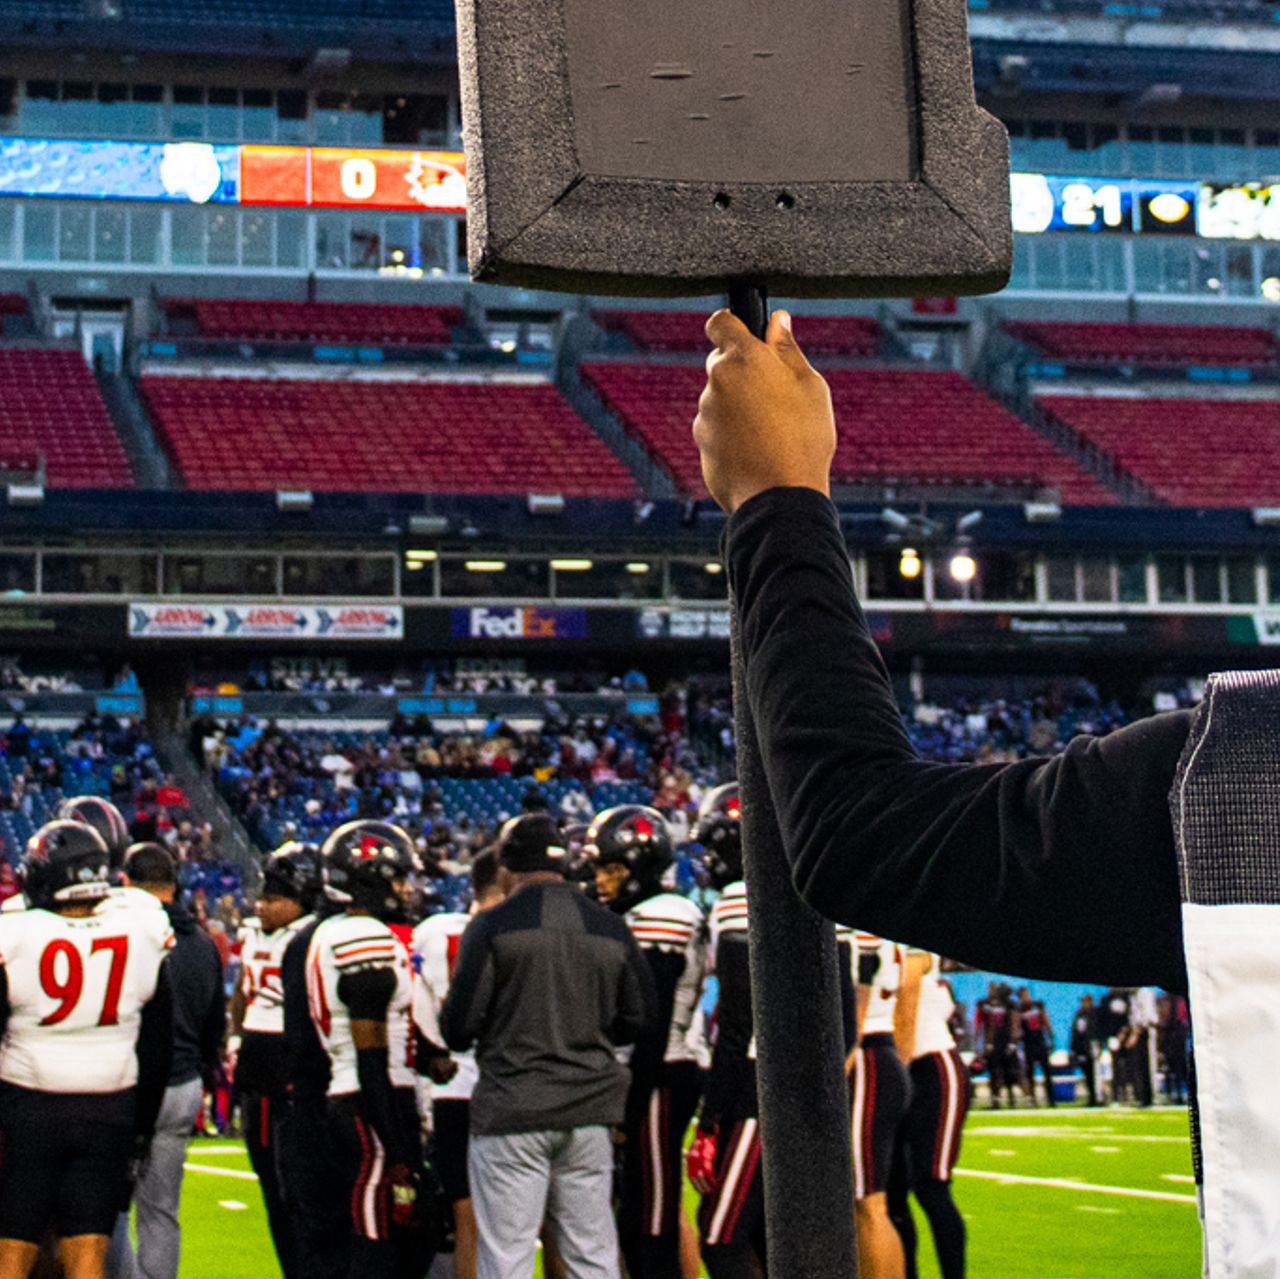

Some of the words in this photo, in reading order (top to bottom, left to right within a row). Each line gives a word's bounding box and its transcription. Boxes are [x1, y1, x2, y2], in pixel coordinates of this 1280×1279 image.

[339, 157, 377, 199] 0
[1061, 184, 1122, 226] 21
[470, 606, 556, 638] FedEx
[38, 933, 129, 1027] 97
